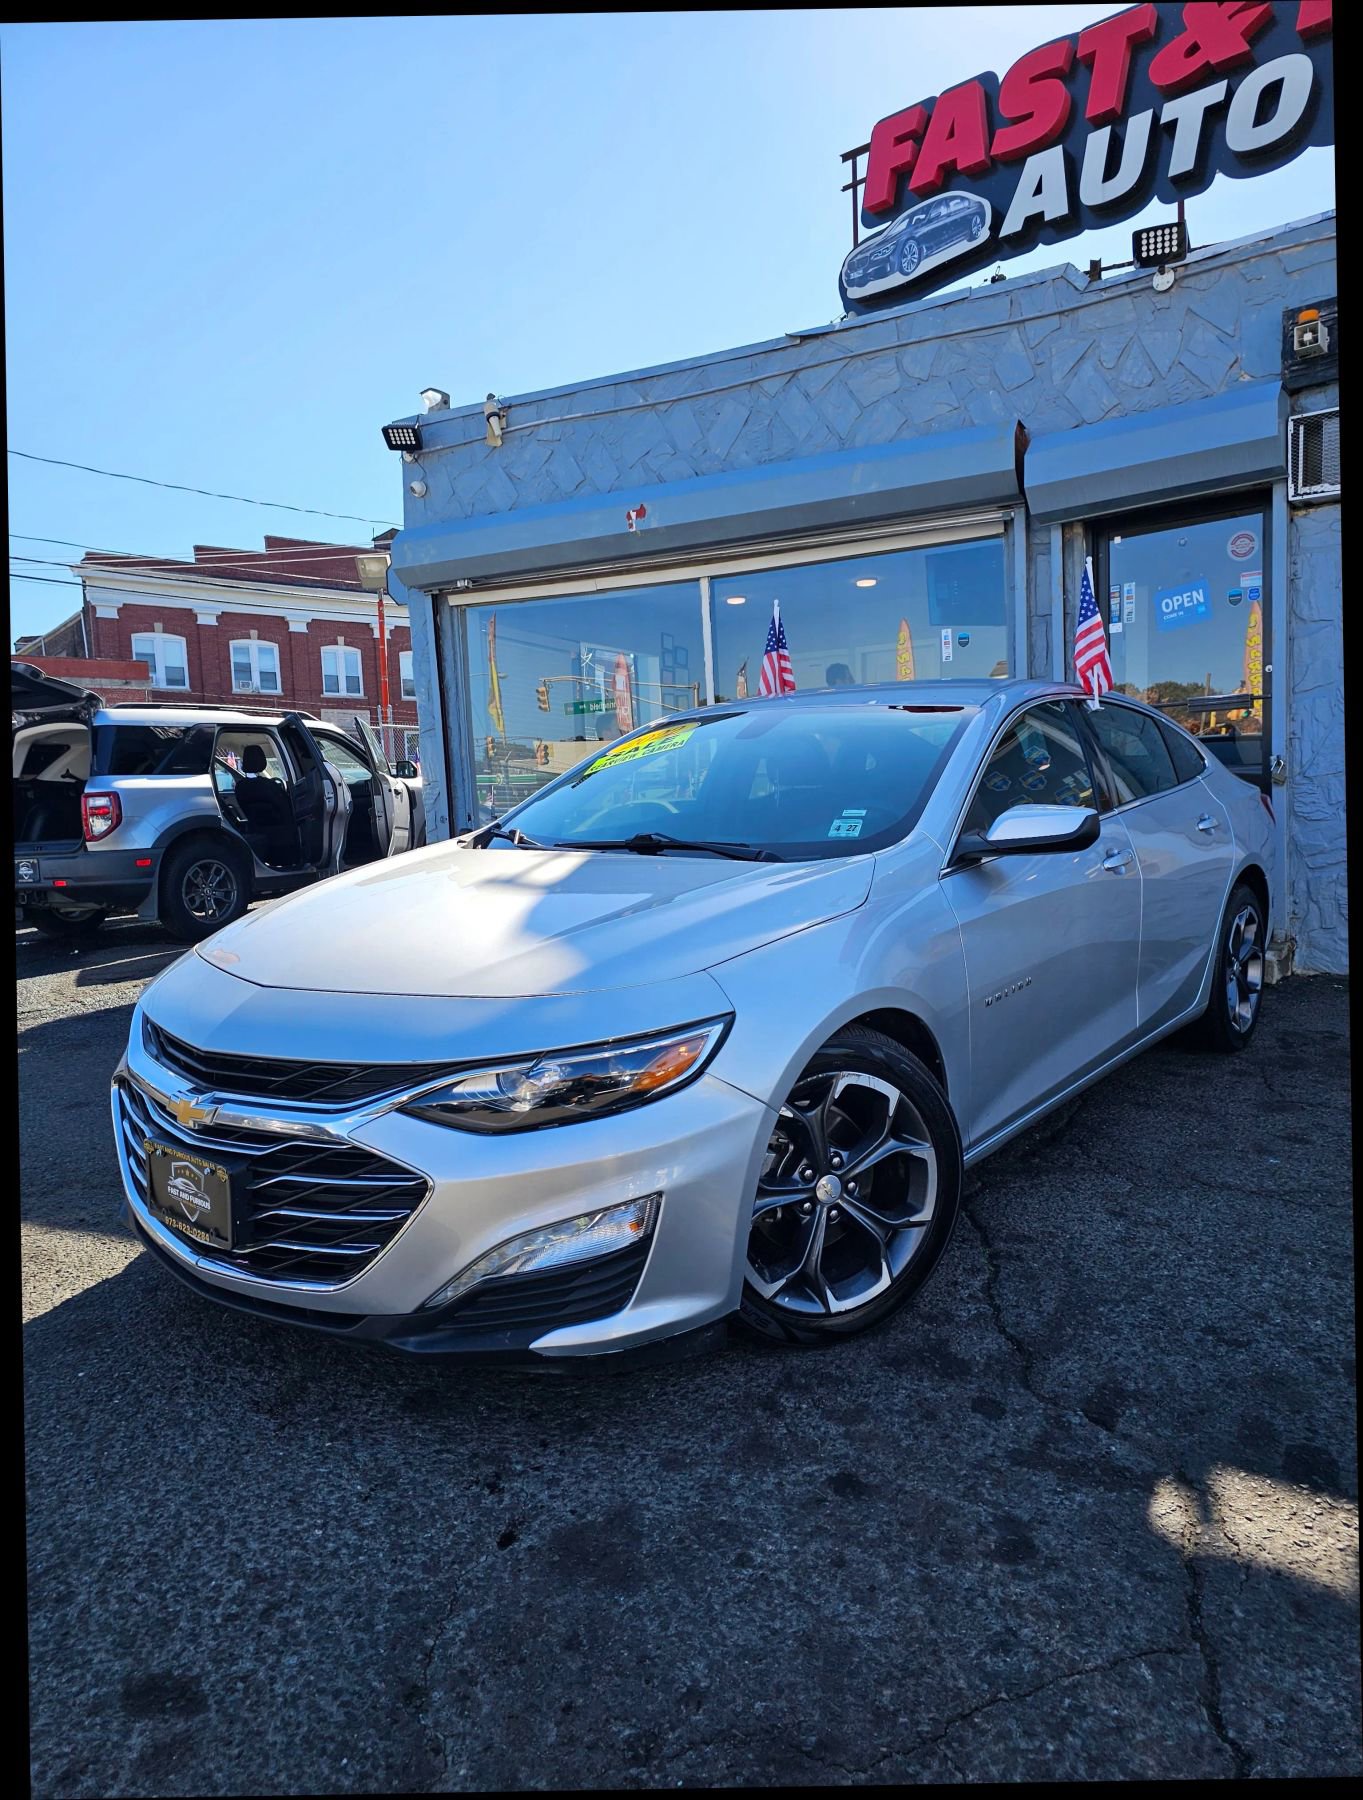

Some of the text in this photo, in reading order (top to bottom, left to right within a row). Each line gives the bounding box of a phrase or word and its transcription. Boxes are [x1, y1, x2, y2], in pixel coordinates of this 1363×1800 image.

[864, 3, 1157, 214] FAST
[999, 54, 1314, 237] AUTO
[1161, 589, 1204, 613] OPEN
[642, 740, 686, 756] CAMERA
[168, 1185, 179, 1196] FAST
[180, 1191, 190, 1201] AND
[190, 1195, 211, 1210] FURIOUS
